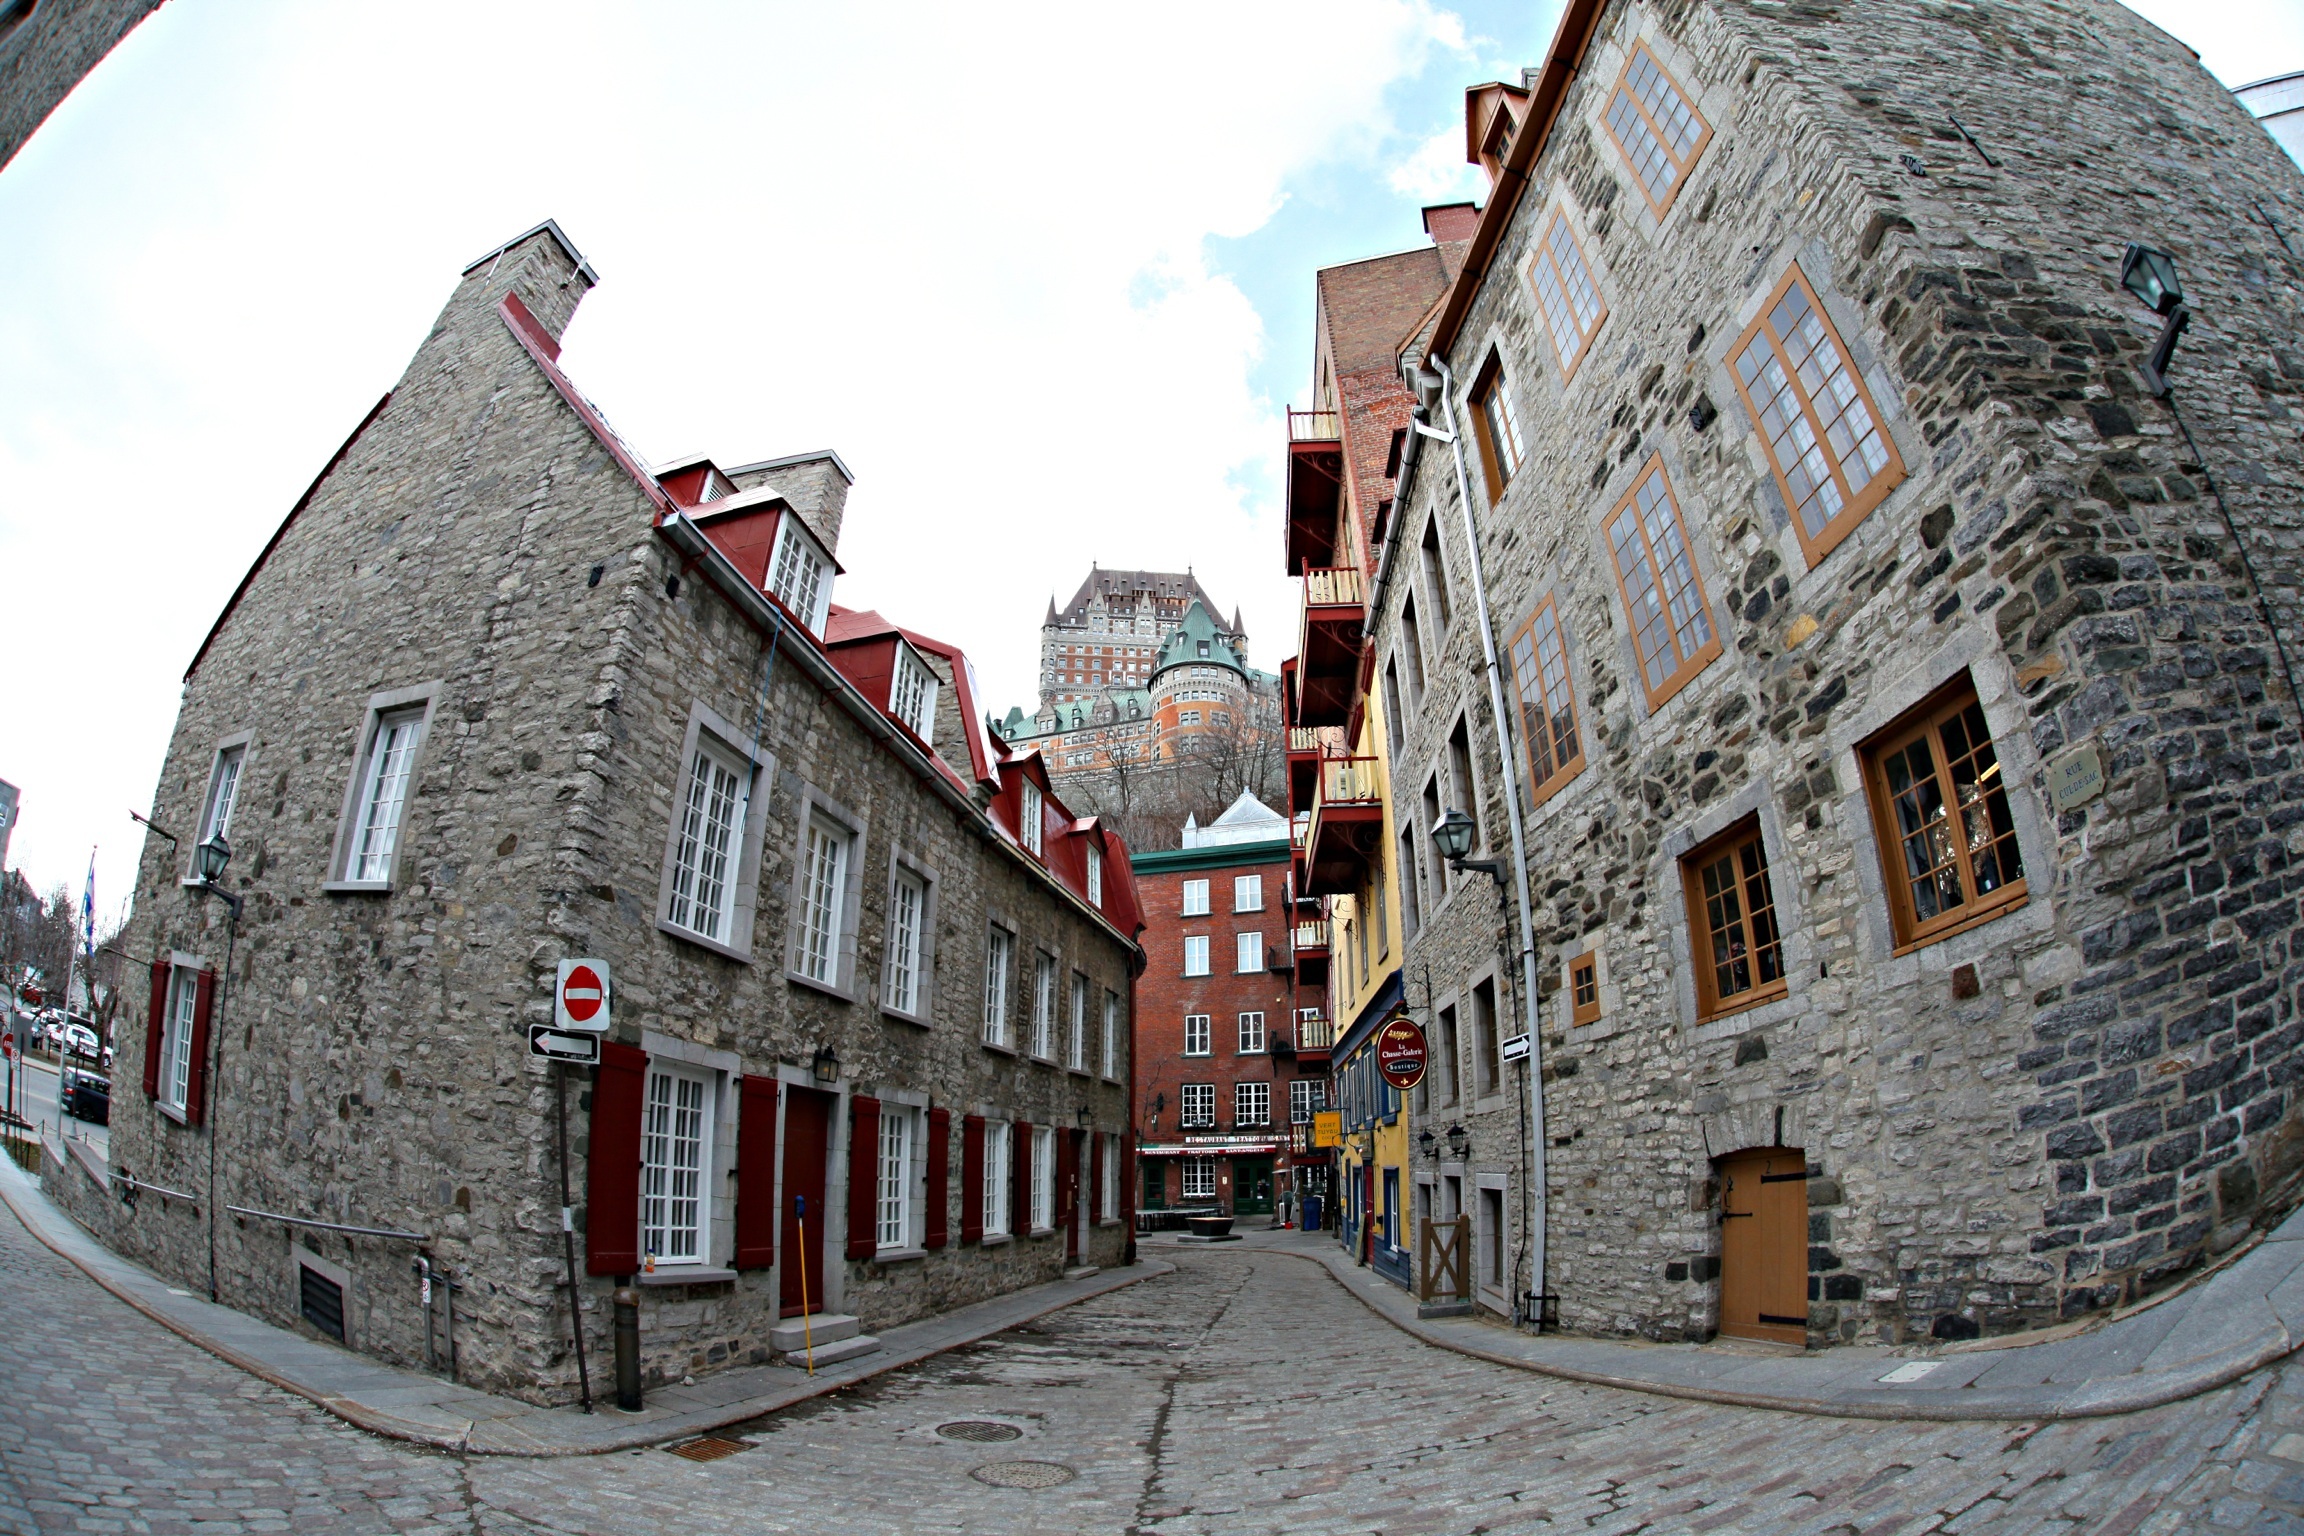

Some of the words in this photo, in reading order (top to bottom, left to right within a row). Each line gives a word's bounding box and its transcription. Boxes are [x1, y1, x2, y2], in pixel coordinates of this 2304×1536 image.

[2065, 761, 2083, 778] RUE
[2058, 770, 2099, 800] CUL-DE-SAC
[1382, 1048, 1423, 1058] Chasse-Galerie
[1765, 1160, 1771, 1174] 2
